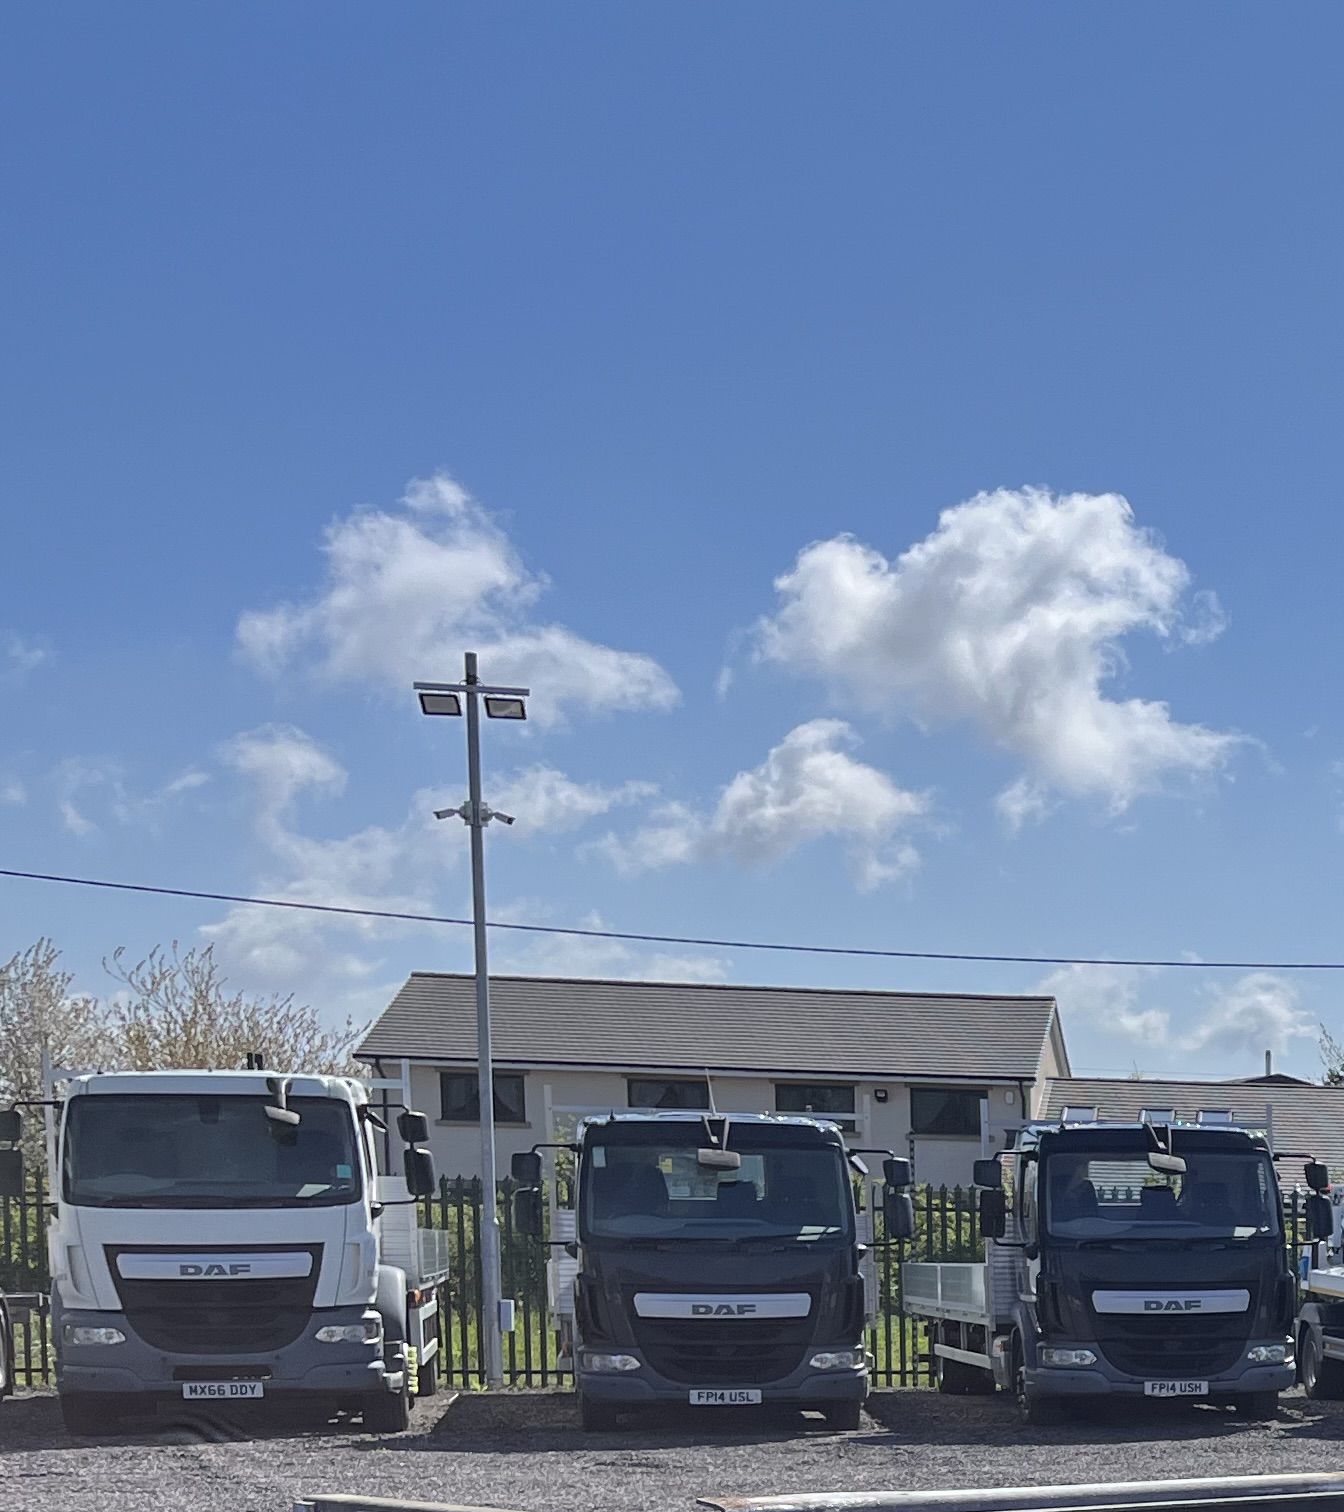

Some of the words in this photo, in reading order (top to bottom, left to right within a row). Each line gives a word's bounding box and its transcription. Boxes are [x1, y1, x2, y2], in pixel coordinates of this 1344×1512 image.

[179, 1264, 251, 1276] DAF
[691, 1304, 757, 1316] DAF
[1143, 1300, 1202, 1311] DAF
[188, 1385, 226, 1396] MX66
[229, 1384, 257, 1396] DDY
[1151, 1382, 1177, 1393] FP14
[1179, 1382, 1202, 1393] USH
[697, 1391, 725, 1403] FP14
[729, 1391, 755, 1403] USL
